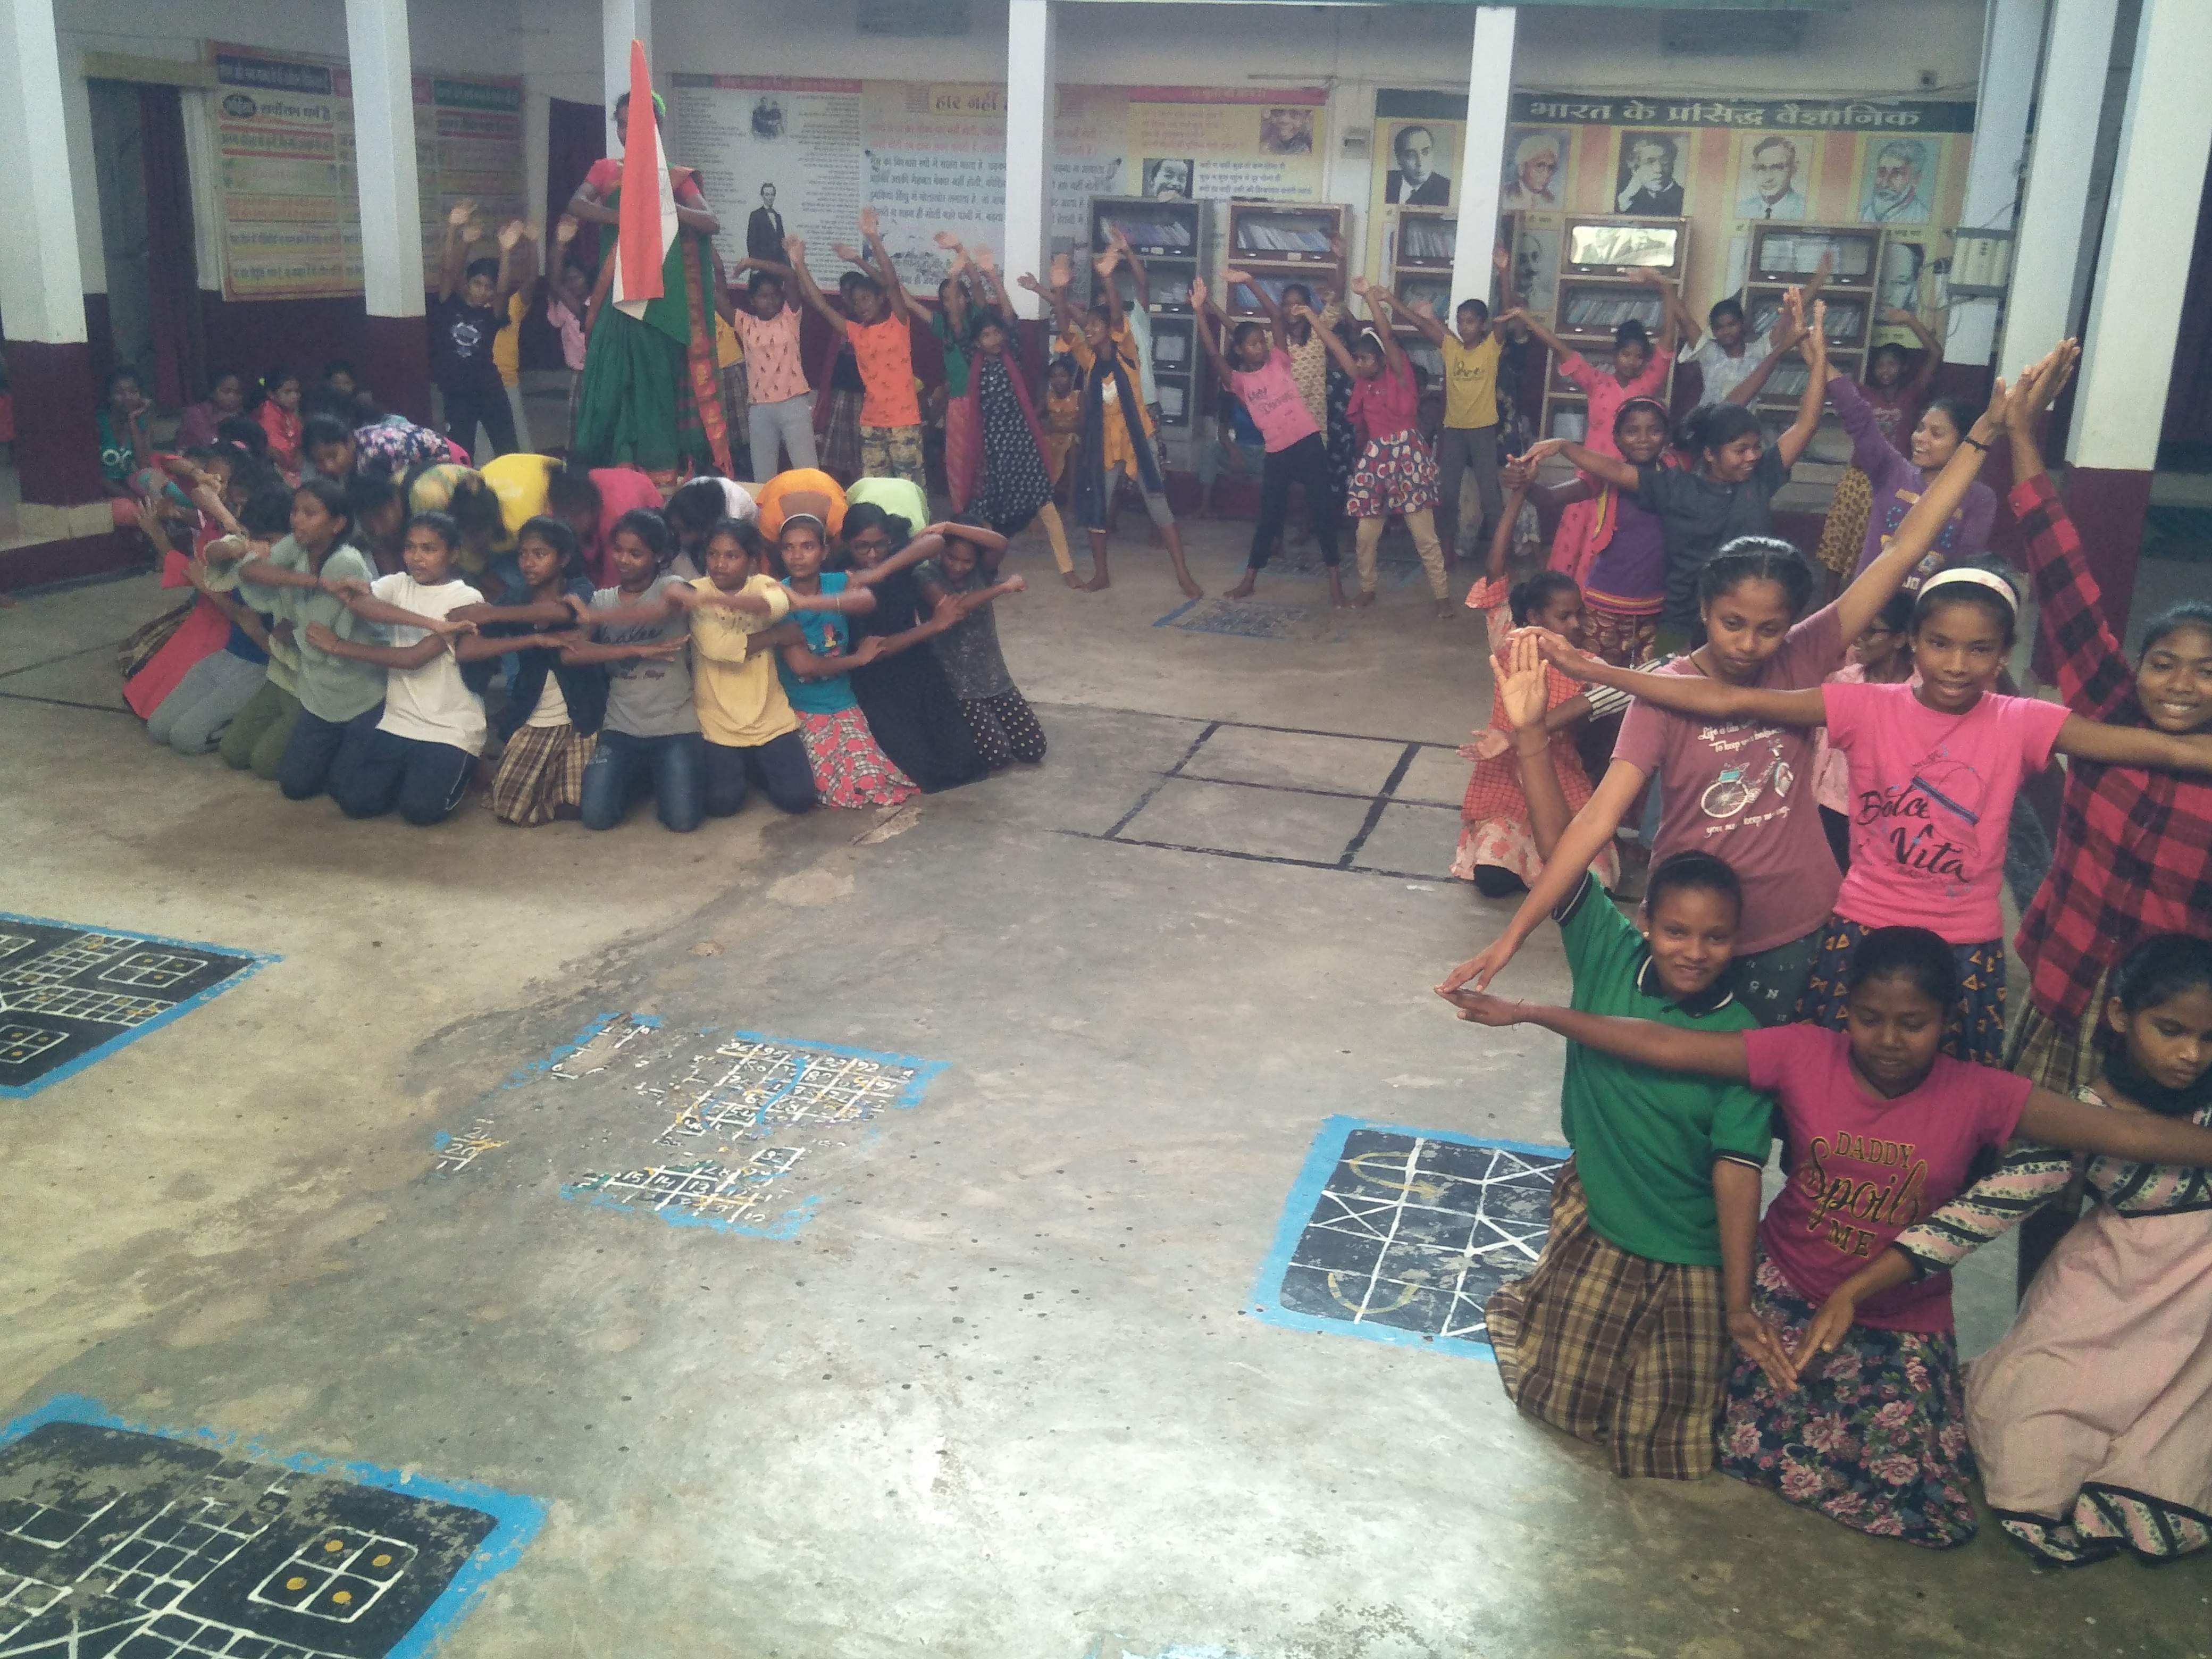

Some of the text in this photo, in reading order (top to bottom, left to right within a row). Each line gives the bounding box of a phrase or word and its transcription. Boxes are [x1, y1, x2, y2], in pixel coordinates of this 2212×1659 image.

[1530, 99, 1921, 127] भारत के प्रसिद्ध वैज्ञानिक
[1889, 824, 1971, 883] Vita
[1833, 1130, 1915, 1169] DADDY
[622, 1171, 710, 1194] 15 14 13
[1825, 1218, 1878, 1259] ME
